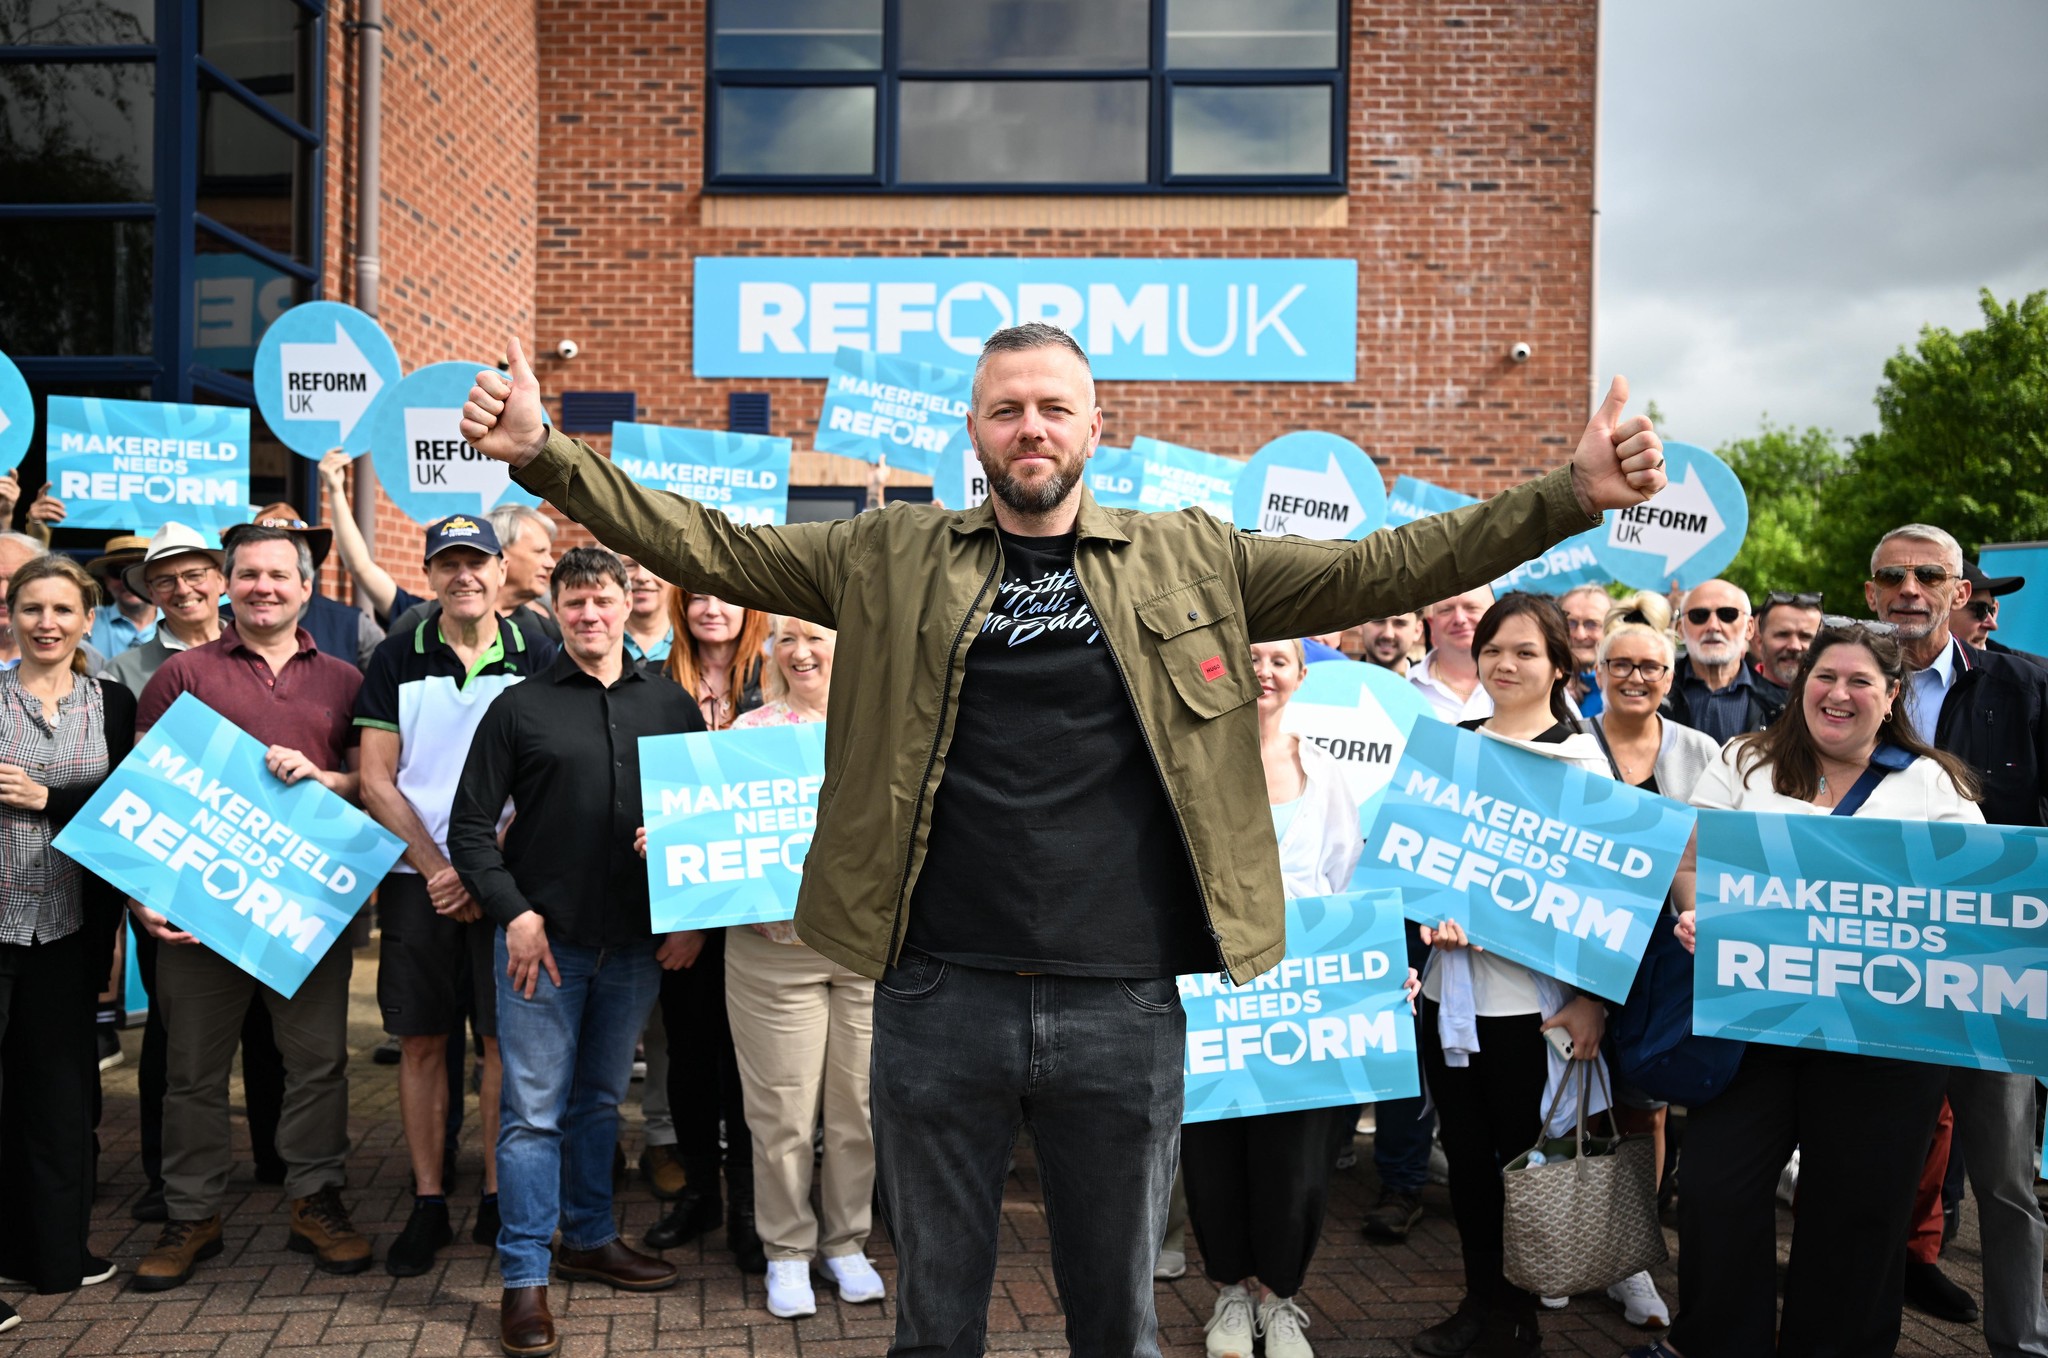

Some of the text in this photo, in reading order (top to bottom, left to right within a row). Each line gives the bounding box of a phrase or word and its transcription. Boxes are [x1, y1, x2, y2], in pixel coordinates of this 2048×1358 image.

[288, 372, 367, 392] REFORM
[838, 375, 969, 418] MAKERFIELD
[289, 394, 313, 414] UK
[872, 401, 929, 424] NEEDS
[61, 433, 238, 462] MAKERFIELD
[415, 440, 498, 461] REFO
[113, 456, 189, 475] NEEDS
[416, 464, 447, 485] UK
[622, 459, 778, 490] MAKERFIELD
[61, 470, 237, 506] REFORM
[1263, 514, 1290, 533] UK
[1267, 493, 1349, 522] REFORM
[1620, 505, 1708, 534] REFORM
[1616, 523, 1644, 545] UK
[1493, 545, 1597, 588] FORM
[1013, 592, 1076, 618] Calls
[1305, 735, 1392, 764] FORM
[661, 776, 825, 816] MAKERF
[147, 744, 357, 895] MAKERFIELD
[734, 806, 817, 834] NEED
[1404, 770, 1653, 879] MAKERFIELD
[189, 807, 285, 878] NEEDS
[665, 832, 815, 887] REFO
[1462, 822, 1567, 878] NEEDS
[99, 788, 326, 955] REFORM
[1378, 822, 1634, 953] REFORM
[1718, 873, 2048, 929] MAKERFIELD
[1807, 915, 1947, 953] NEEDS
[1179, 950, 1390, 998] AKRFIELD
[1716, 939, 2047, 1020] REFORM
[1215, 989, 1322, 1023] NEEDS
[1184, 1010, 1398, 1076] EFORM
